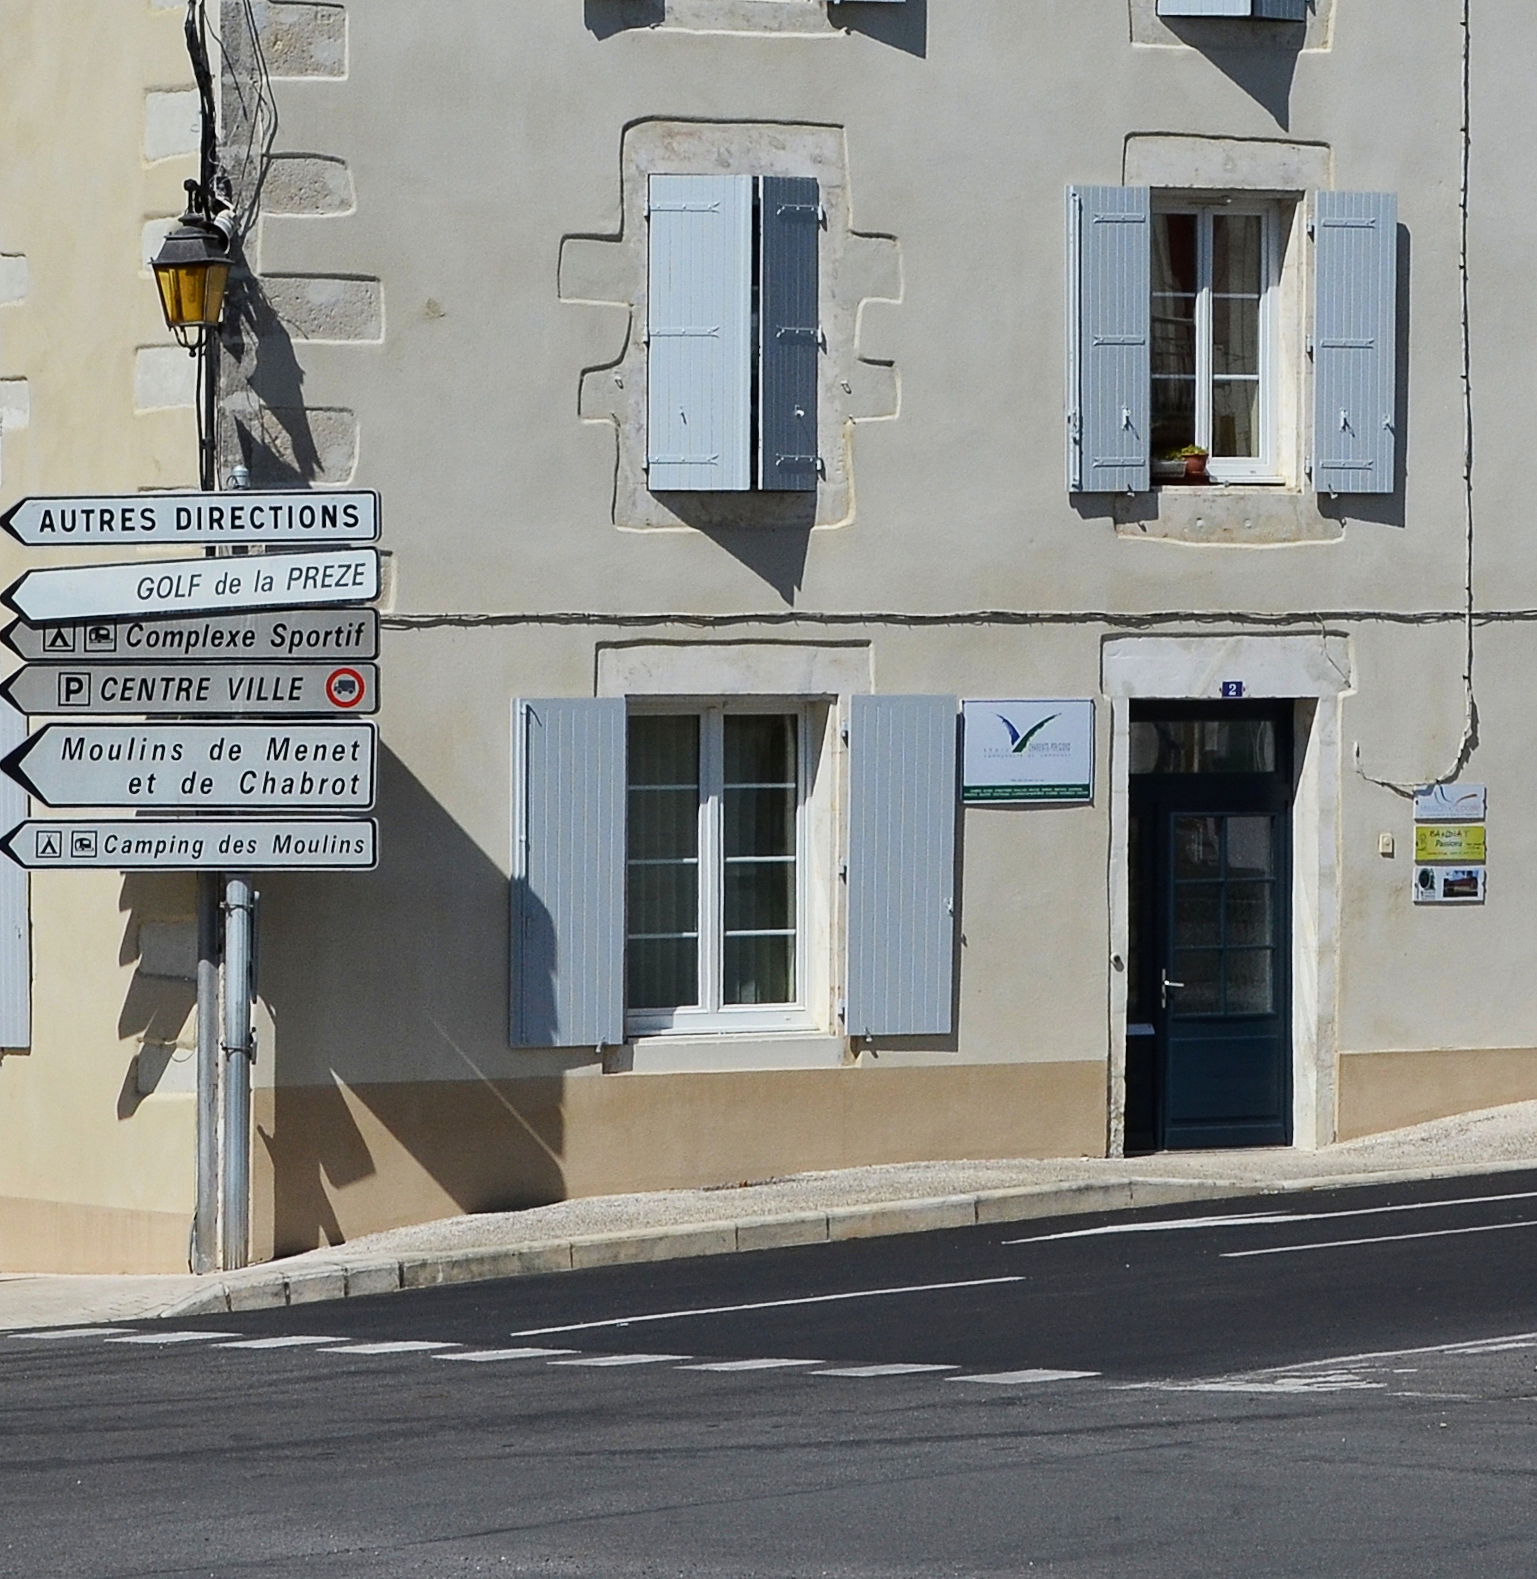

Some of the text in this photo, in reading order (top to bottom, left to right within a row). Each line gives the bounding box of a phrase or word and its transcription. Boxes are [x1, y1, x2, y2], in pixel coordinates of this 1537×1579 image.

[39, 504, 359, 532] AUTRES DIRECTIONS
[137, 563, 365, 600] GOLF de la PREZE
[126, 622, 364, 654] Complexe Sportif
[65, 677, 304, 702] P CENTRE VILLE
[1228, 683, 1237, 696] 2
[62, 737, 360, 761] Moulins de Menet
[128, 771, 360, 795] et de Chabrot
[103, 834, 364, 859] Camping des Moulins
